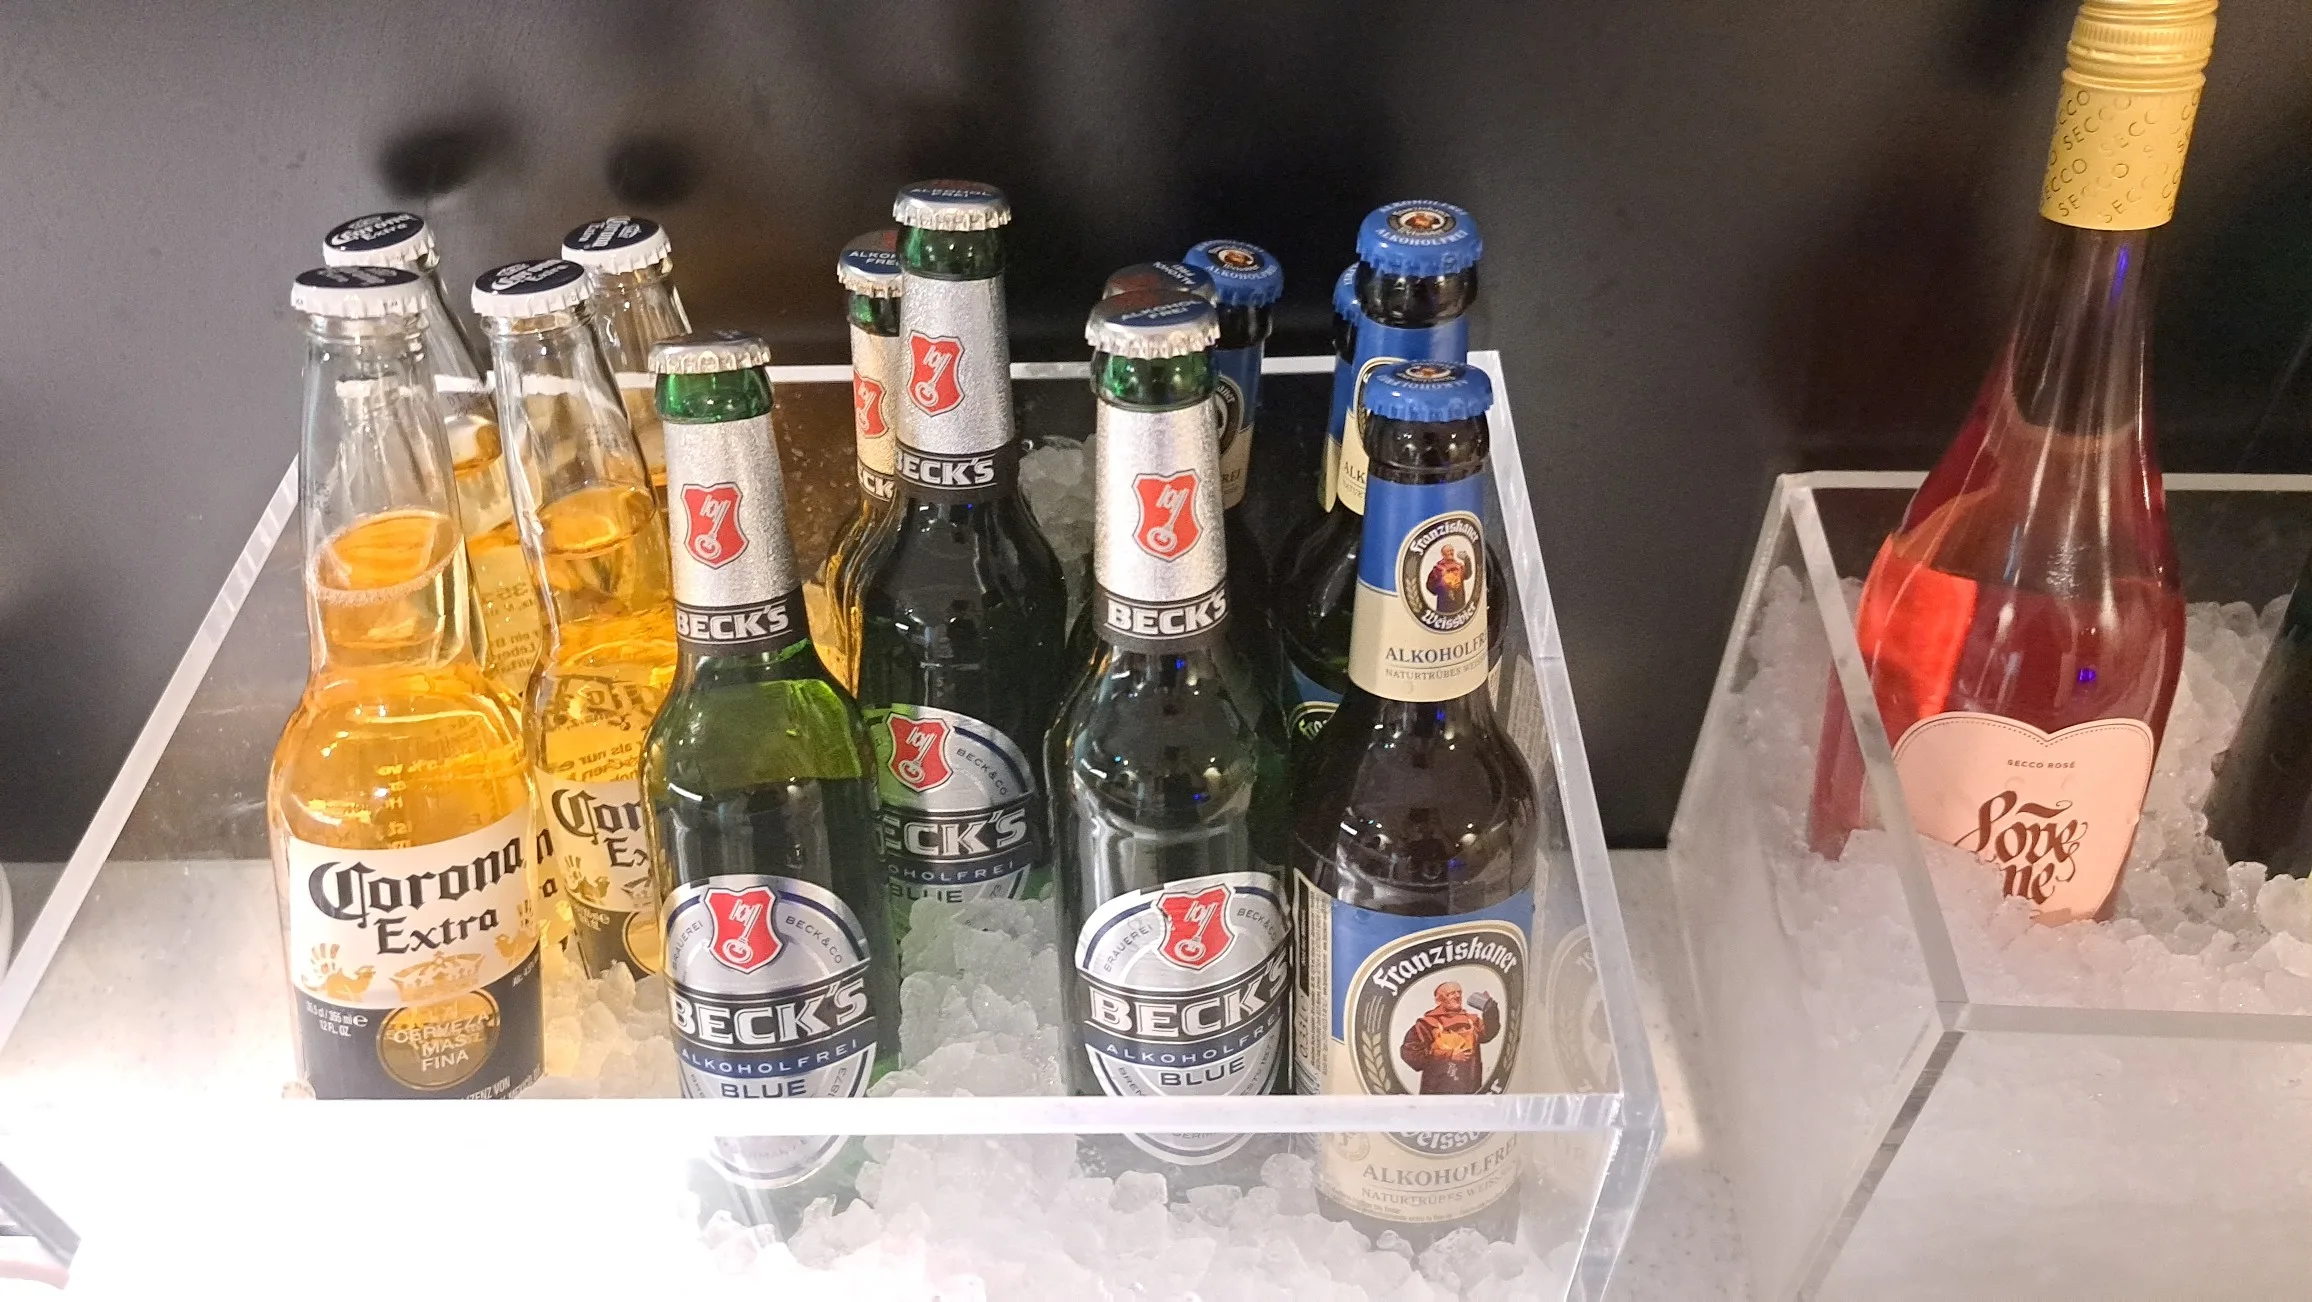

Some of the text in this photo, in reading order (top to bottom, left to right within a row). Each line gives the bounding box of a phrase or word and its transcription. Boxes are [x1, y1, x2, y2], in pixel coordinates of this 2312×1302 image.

[1375, 228, 1469, 246] ALKOHOLFREI
[1409, 519, 1480, 556] Franziskaner
[675, 604, 790, 640] BECK'S
[1107, 588, 1228, 634] BECK'S
[1422, 602, 1475, 630] Weissbier
[2007, 758, 2044, 769] SECCO
[881, 807, 1028, 858] ECK'S
[309, 837, 524, 929] Corona
[374, 908, 500, 955] Extra
[1104, 923, 1154, 973] BRAUEREI
[1372, 936, 1519, 997] Franziskaner
[668, 977, 869, 1046] BECK'S
[1088, 952, 1288, 1039] BECK'S
[681, 1038, 858, 1074] ALKOHOLFREI
[1106, 1008, 1281, 1065] ALKOHOLFREI
[420, 1049, 469, 1072] FINA
[1160, 1056, 1246, 1087] BLUE
[720, 1079, 807, 1099] BLUE
[1362, 1132, 1518, 1187] ALKOHOLFREI
